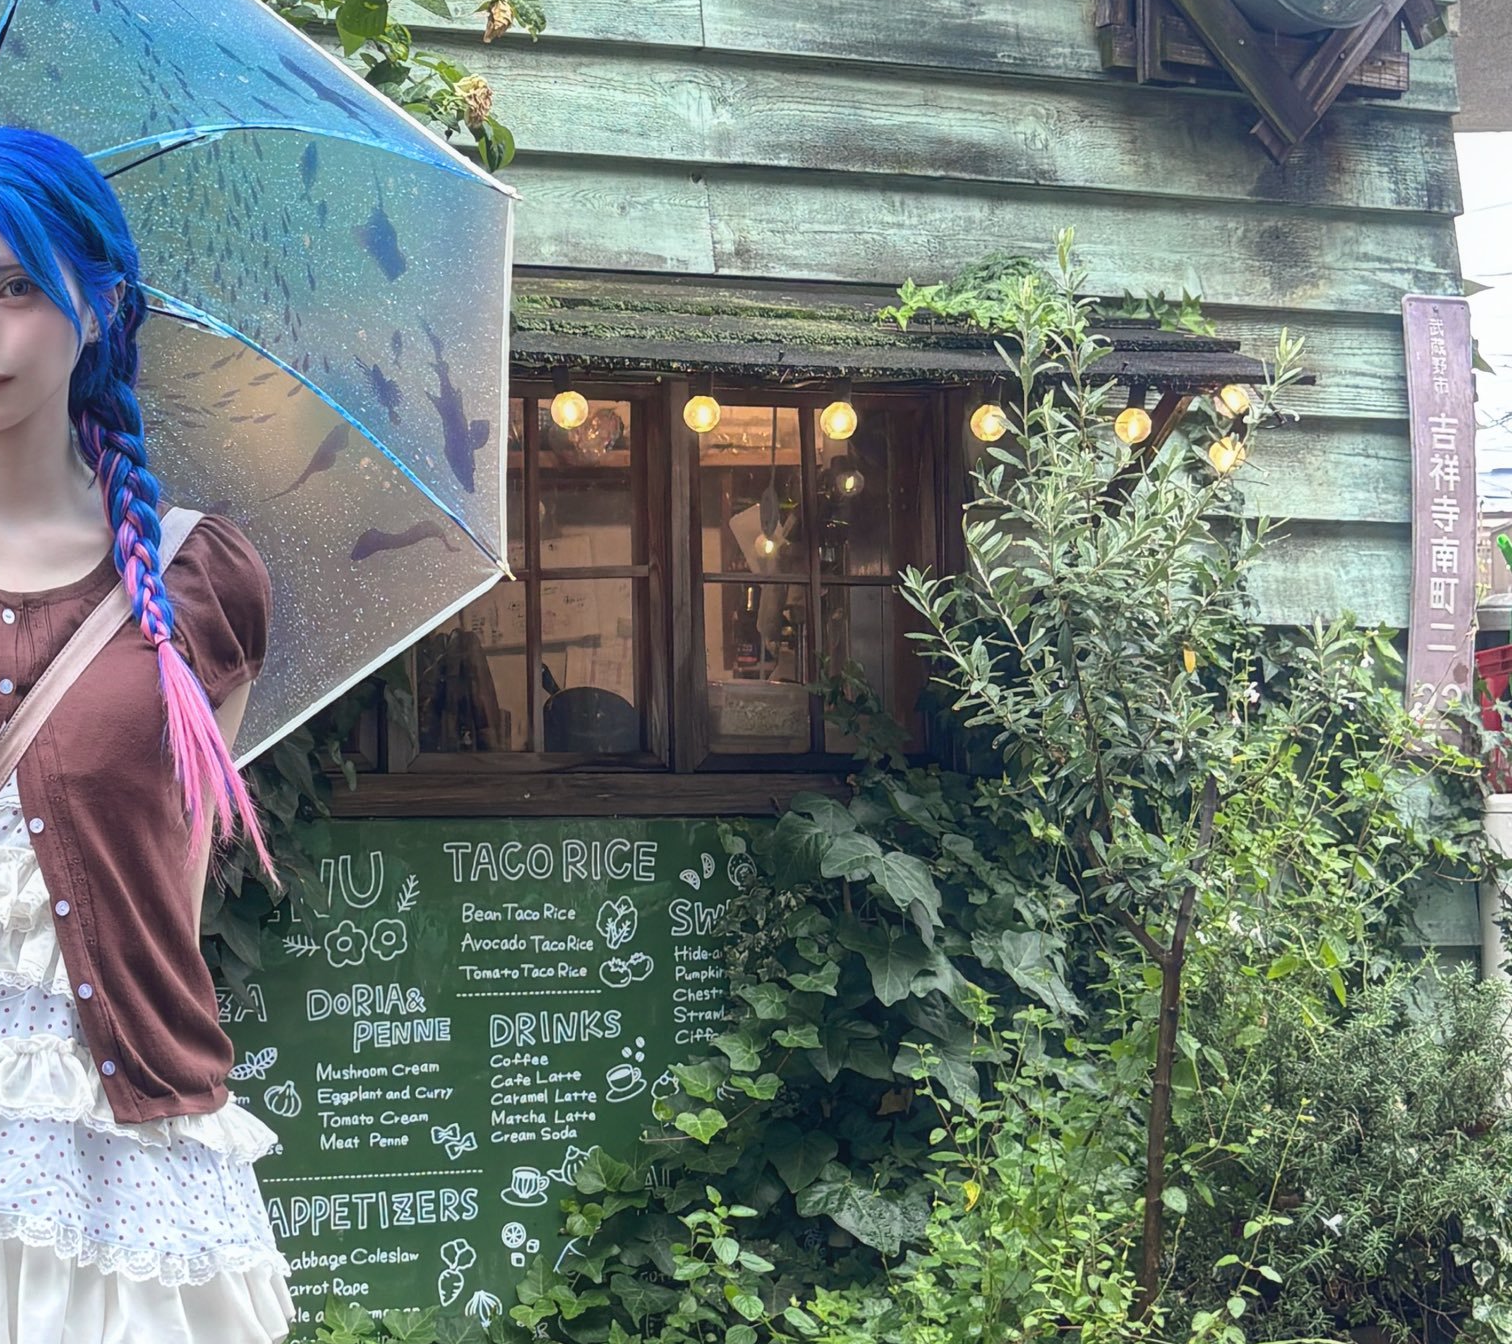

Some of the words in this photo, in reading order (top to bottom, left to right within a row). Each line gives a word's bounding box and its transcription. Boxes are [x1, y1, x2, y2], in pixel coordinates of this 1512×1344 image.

[1428, 318, 1449, 394] 武蔵野市
[443, 841, 554, 883] TACO
[562, 838, 659, 883] RICE
[461, 902, 502, 923] Bean
[502, 902, 541, 921] Taco
[542, 902, 577, 921] Rice
[460, 932, 527, 953] Avocado
[529, 934, 566, 954] Taco
[566, 934, 595, 952] Rice
[673, 945, 723, 963] Hide-a
[458, 964, 520, 981] Tomato
[520, 963, 556, 979] Taco
[557, 961, 588, 978] Rice
[672, 986, 724, 1003] Chest
[353, 1018, 451, 1054] PENNE
[490, 1009, 622, 1048] DRINKS
[490, 1053, 550, 1068] Coffee
[316, 1062, 388, 1083] Mushroom
[391, 1062, 440, 1076] Cream
[490, 1073, 532, 1089] Cafe
[536, 1070, 582, 1084] Latte
[317, 1085, 383, 1107] Eggplant
[385, 1085, 411, 1100] and
[415, 1086, 454, 1101] Curry
[490, 1088, 549, 1106] Caramel
[554, 1088, 598, 1104] Latte
[317, 1111, 375, 1129] Tomato
[379, 1110, 429, 1126] Cream
[491, 1109, 547, 1126] Matcha
[554, 1110, 597, 1124] Latte
[319, 1132, 361, 1152] Meat
[369, 1131, 410, 1149] Penne
[490, 1131, 536, 1143] Cream
[540, 1124, 578, 1141] Soda
[267, 1187, 479, 1238] APPETIZERS
[284, 1250, 348, 1271] abbage
[350, 1246, 420, 1265] Coleslaw
[288, 1280, 330, 1297] arrot
[332, 1277, 370, 1296] Rape
